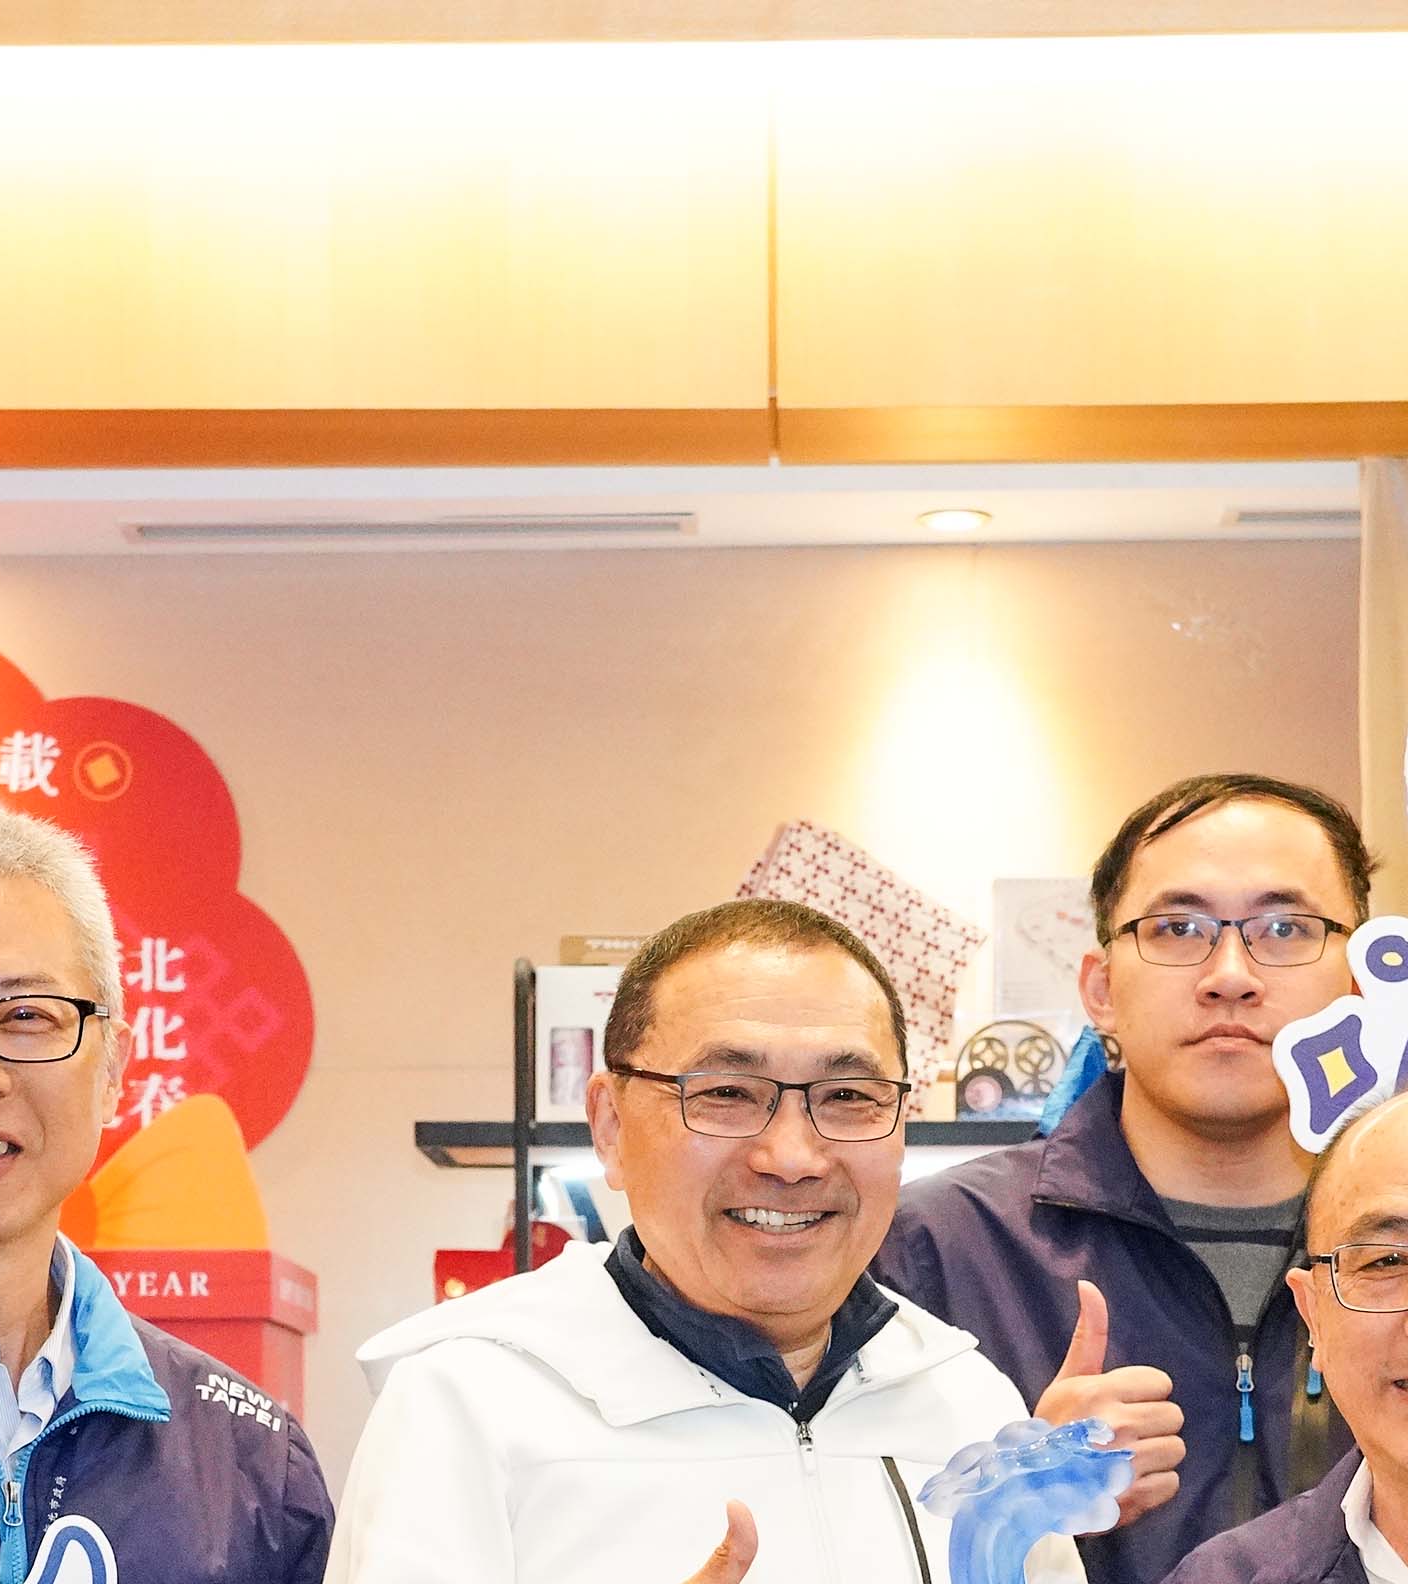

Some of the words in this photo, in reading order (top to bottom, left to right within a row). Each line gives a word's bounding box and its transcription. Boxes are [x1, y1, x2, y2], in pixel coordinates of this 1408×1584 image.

[114, 936, 187, 993] 北
[113, 1271, 209, 1297] YEAR
[195, 1384, 281, 1432] TAIPEI
[208, 1374, 273, 1411] NEW
